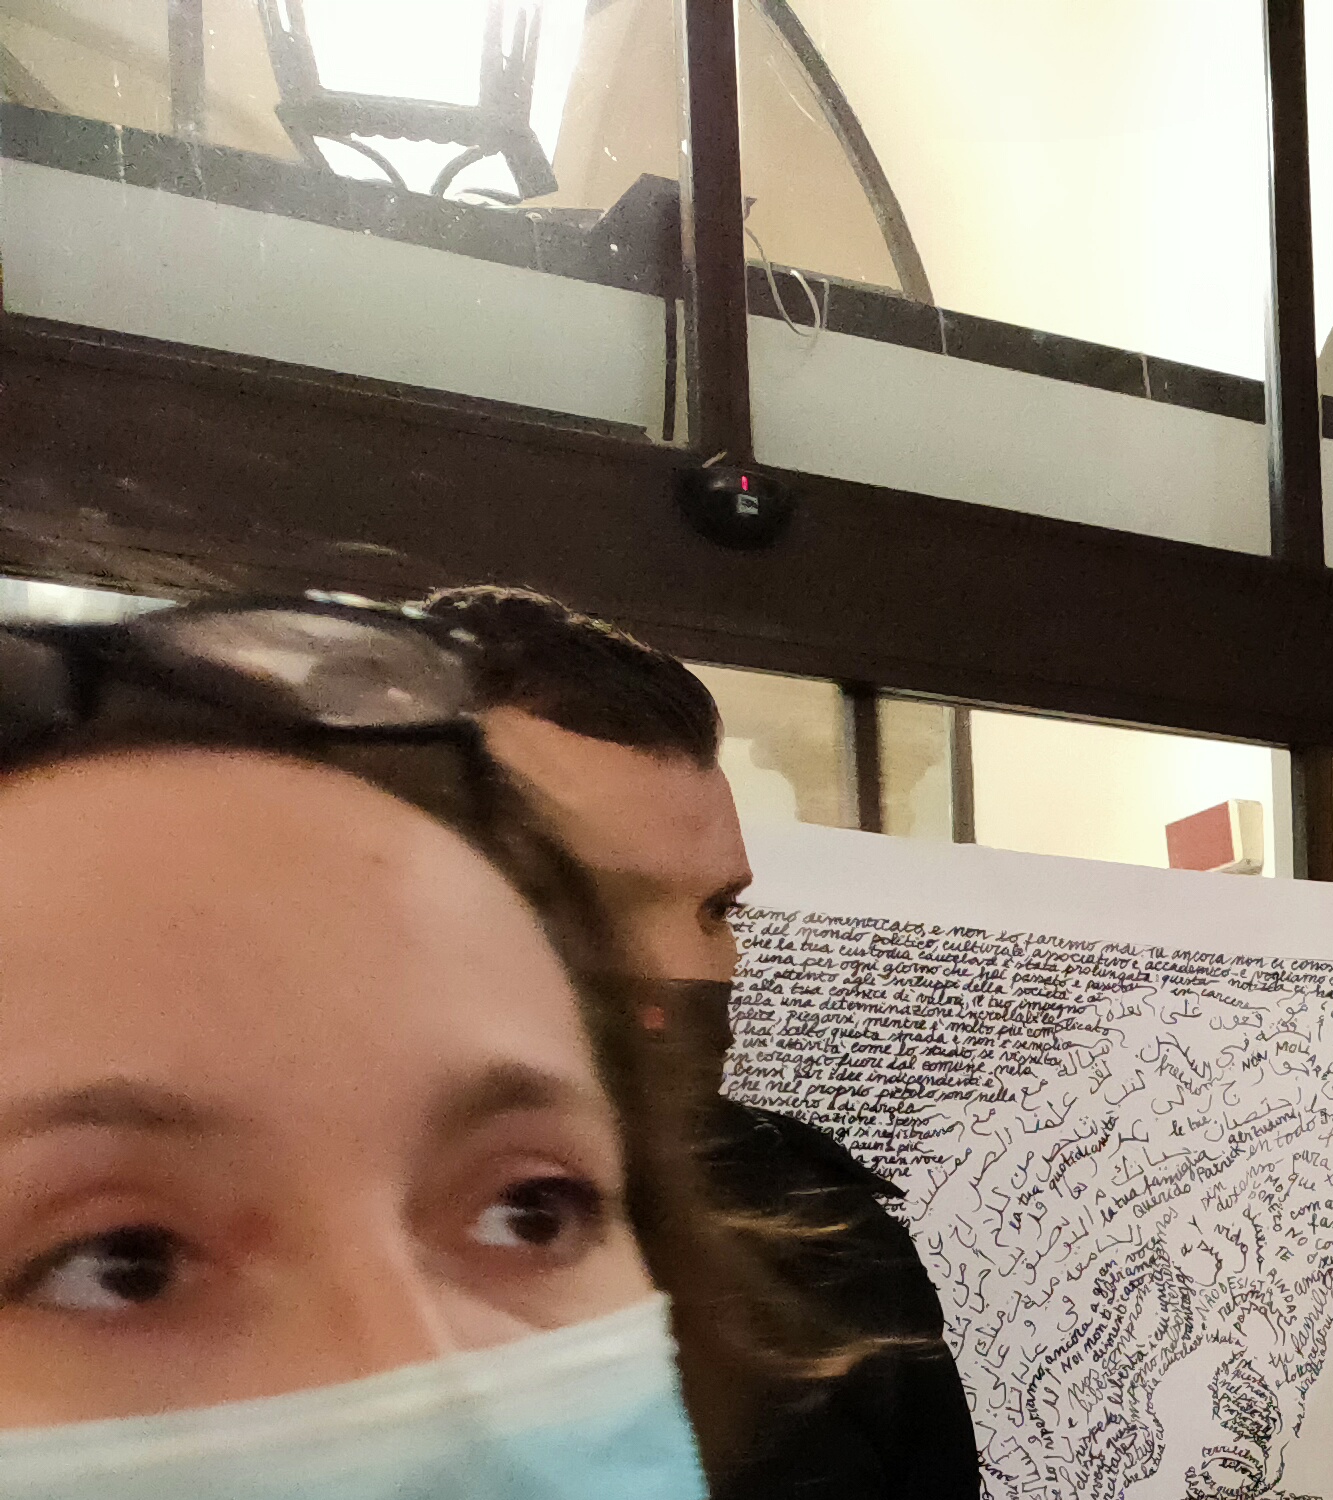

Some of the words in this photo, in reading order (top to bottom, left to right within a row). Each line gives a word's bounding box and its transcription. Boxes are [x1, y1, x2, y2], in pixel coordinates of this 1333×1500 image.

[760, 924, 790, 936] del
[930, 924, 944, 935] e
[946, 924, 994, 940] non
[1025, 932, 1101, 951] faremo
[1171, 949, 1231, 968] ancora
[1230, 956, 1266, 968] non
[757, 952, 800, 966] una
[798, 955, 839, 971] per
[840, 958, 878, 977] ogni
[1241, 1050, 1268, 1073] NON
